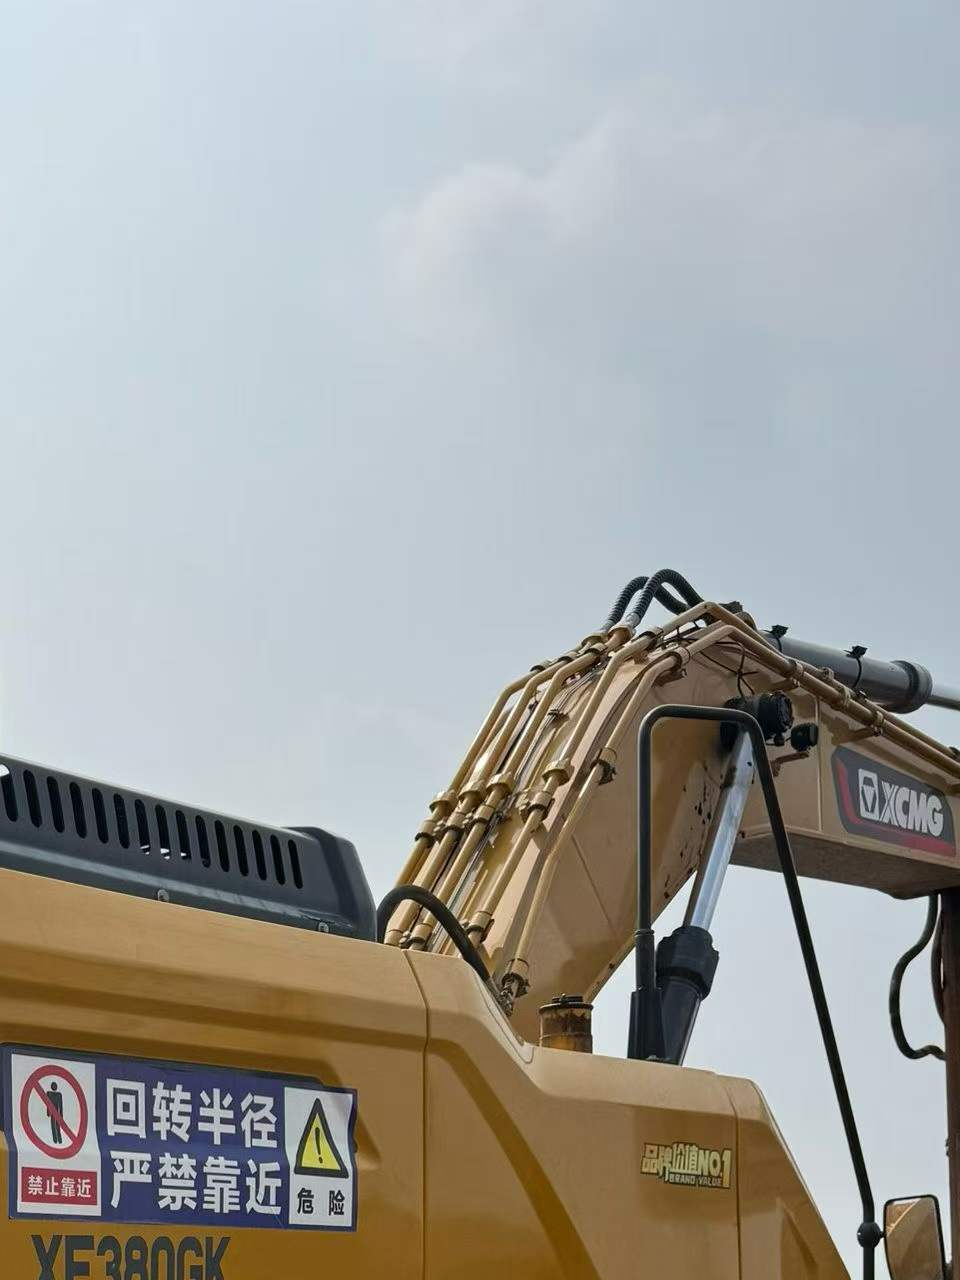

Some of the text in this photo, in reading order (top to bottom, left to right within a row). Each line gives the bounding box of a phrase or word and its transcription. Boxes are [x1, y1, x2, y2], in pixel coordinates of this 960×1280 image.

[880, 780, 944, 837] XCMG
[106, 1078, 278, 1149] 回转半径
[27, 1174, 93, 1199] 禁止靠近
[109, 1150, 282, 1216] 严禁靠近
[296, 1187, 345, 1217] 危险
[669, 1174, 723, 1187] BRAND VALUE
